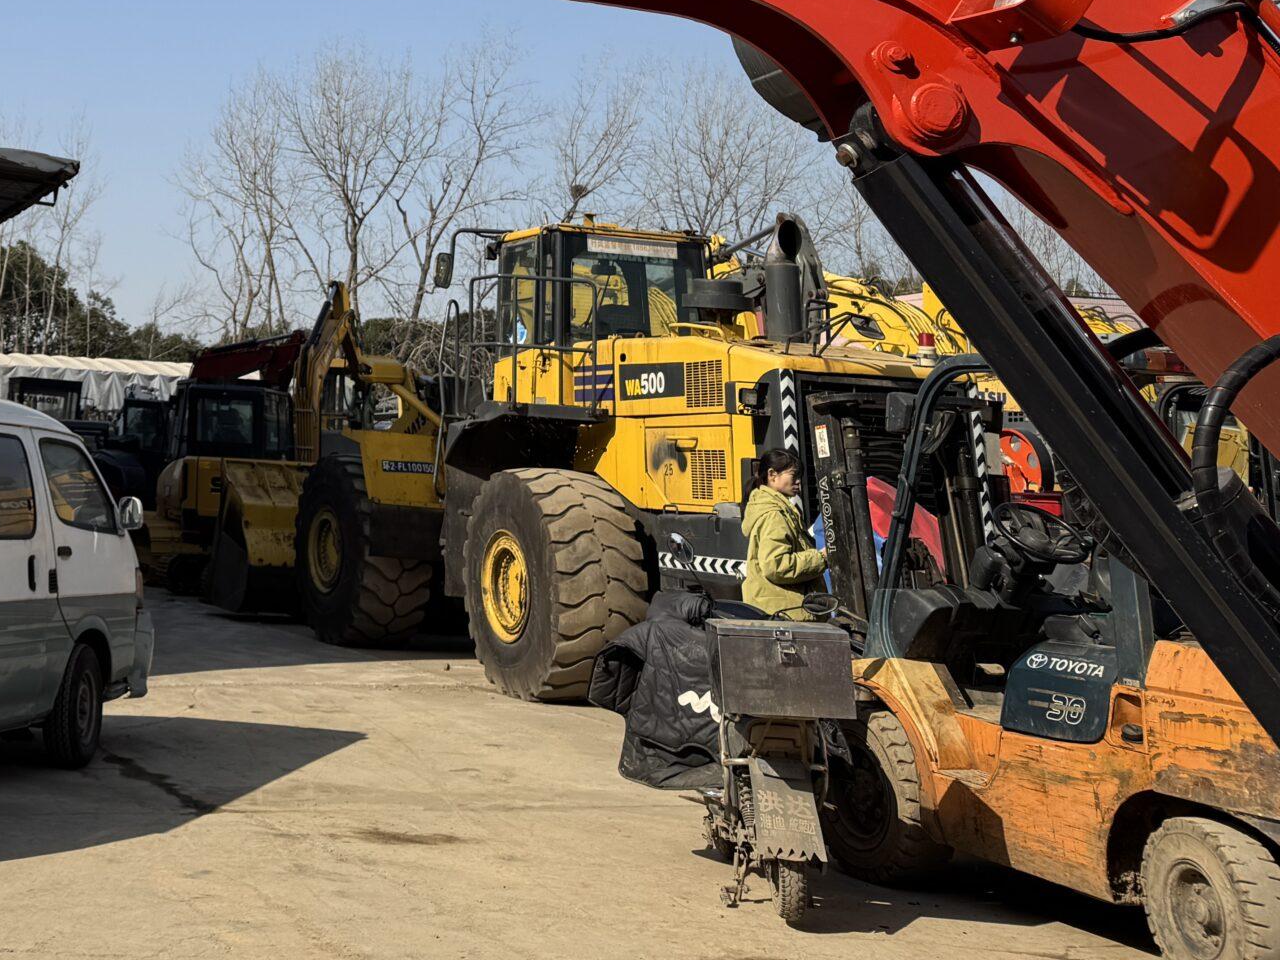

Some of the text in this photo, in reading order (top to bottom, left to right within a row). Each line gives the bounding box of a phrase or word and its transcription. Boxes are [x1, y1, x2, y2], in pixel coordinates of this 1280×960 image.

[625, 371, 666, 397] WA500
[818, 475, 837, 554] TOYOTA
[1048, 657, 1105, 678] TOYOTA
[1045, 693, 1087, 726] 30
